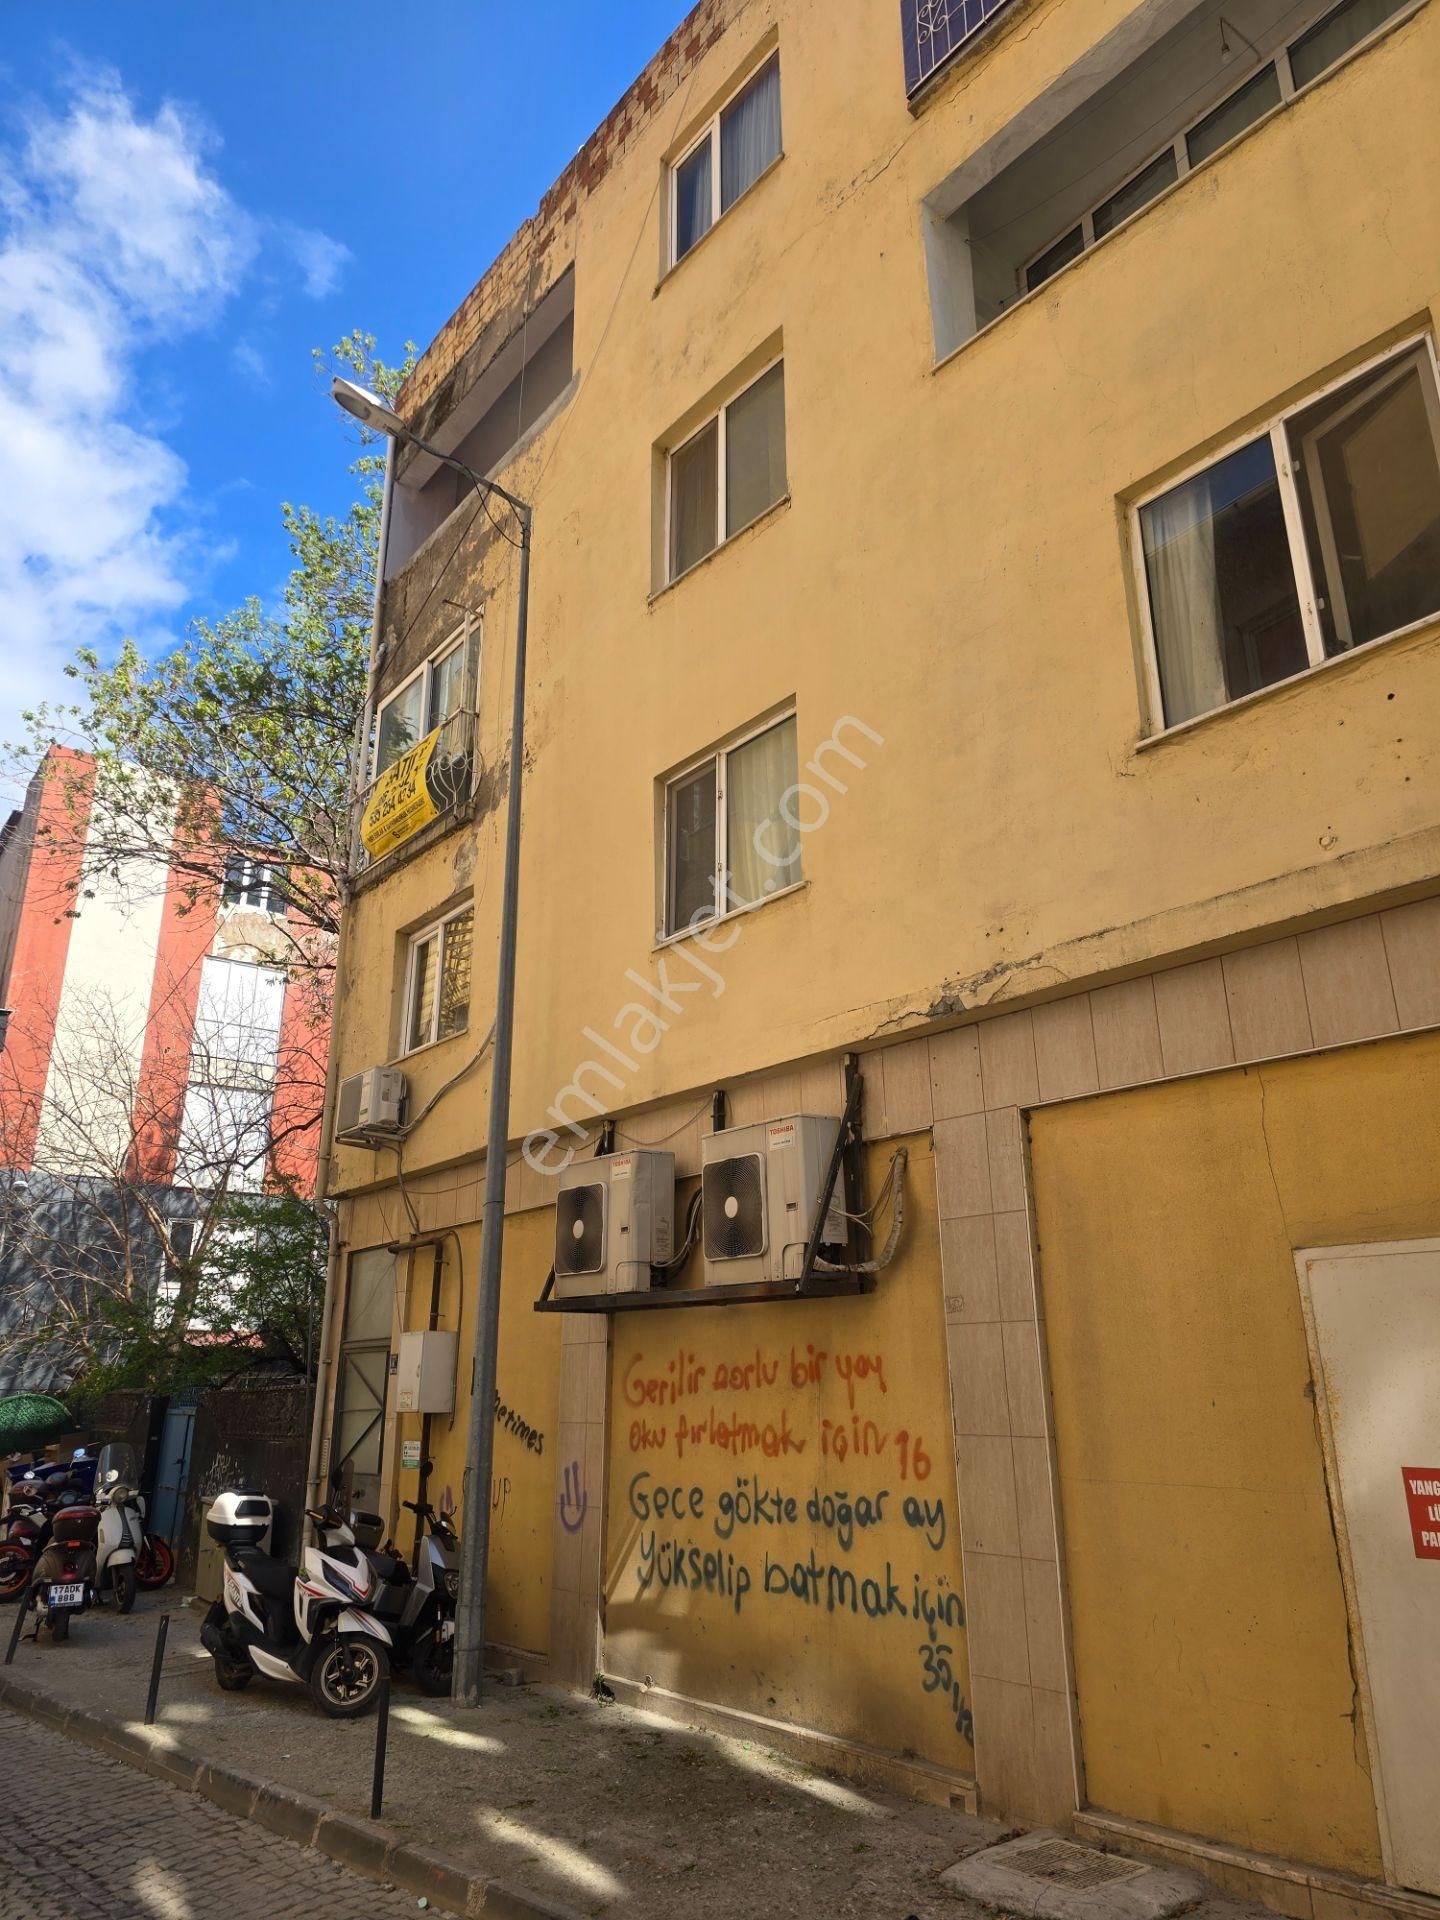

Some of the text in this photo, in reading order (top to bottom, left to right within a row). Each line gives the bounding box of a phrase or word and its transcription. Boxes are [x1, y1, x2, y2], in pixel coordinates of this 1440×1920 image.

[769, 1124, 794, 1136] TOSHIBA
[624, 1349, 706, 1407] Gerilir
[791, 1344, 828, 1390] bir
[895, 1430, 931, 1481] 16
[629, 1472, 947, 1553] Gece gökte doğar ay
[764, 1548, 906, 1618] batmak
[912, 1573, 965, 1642] için
